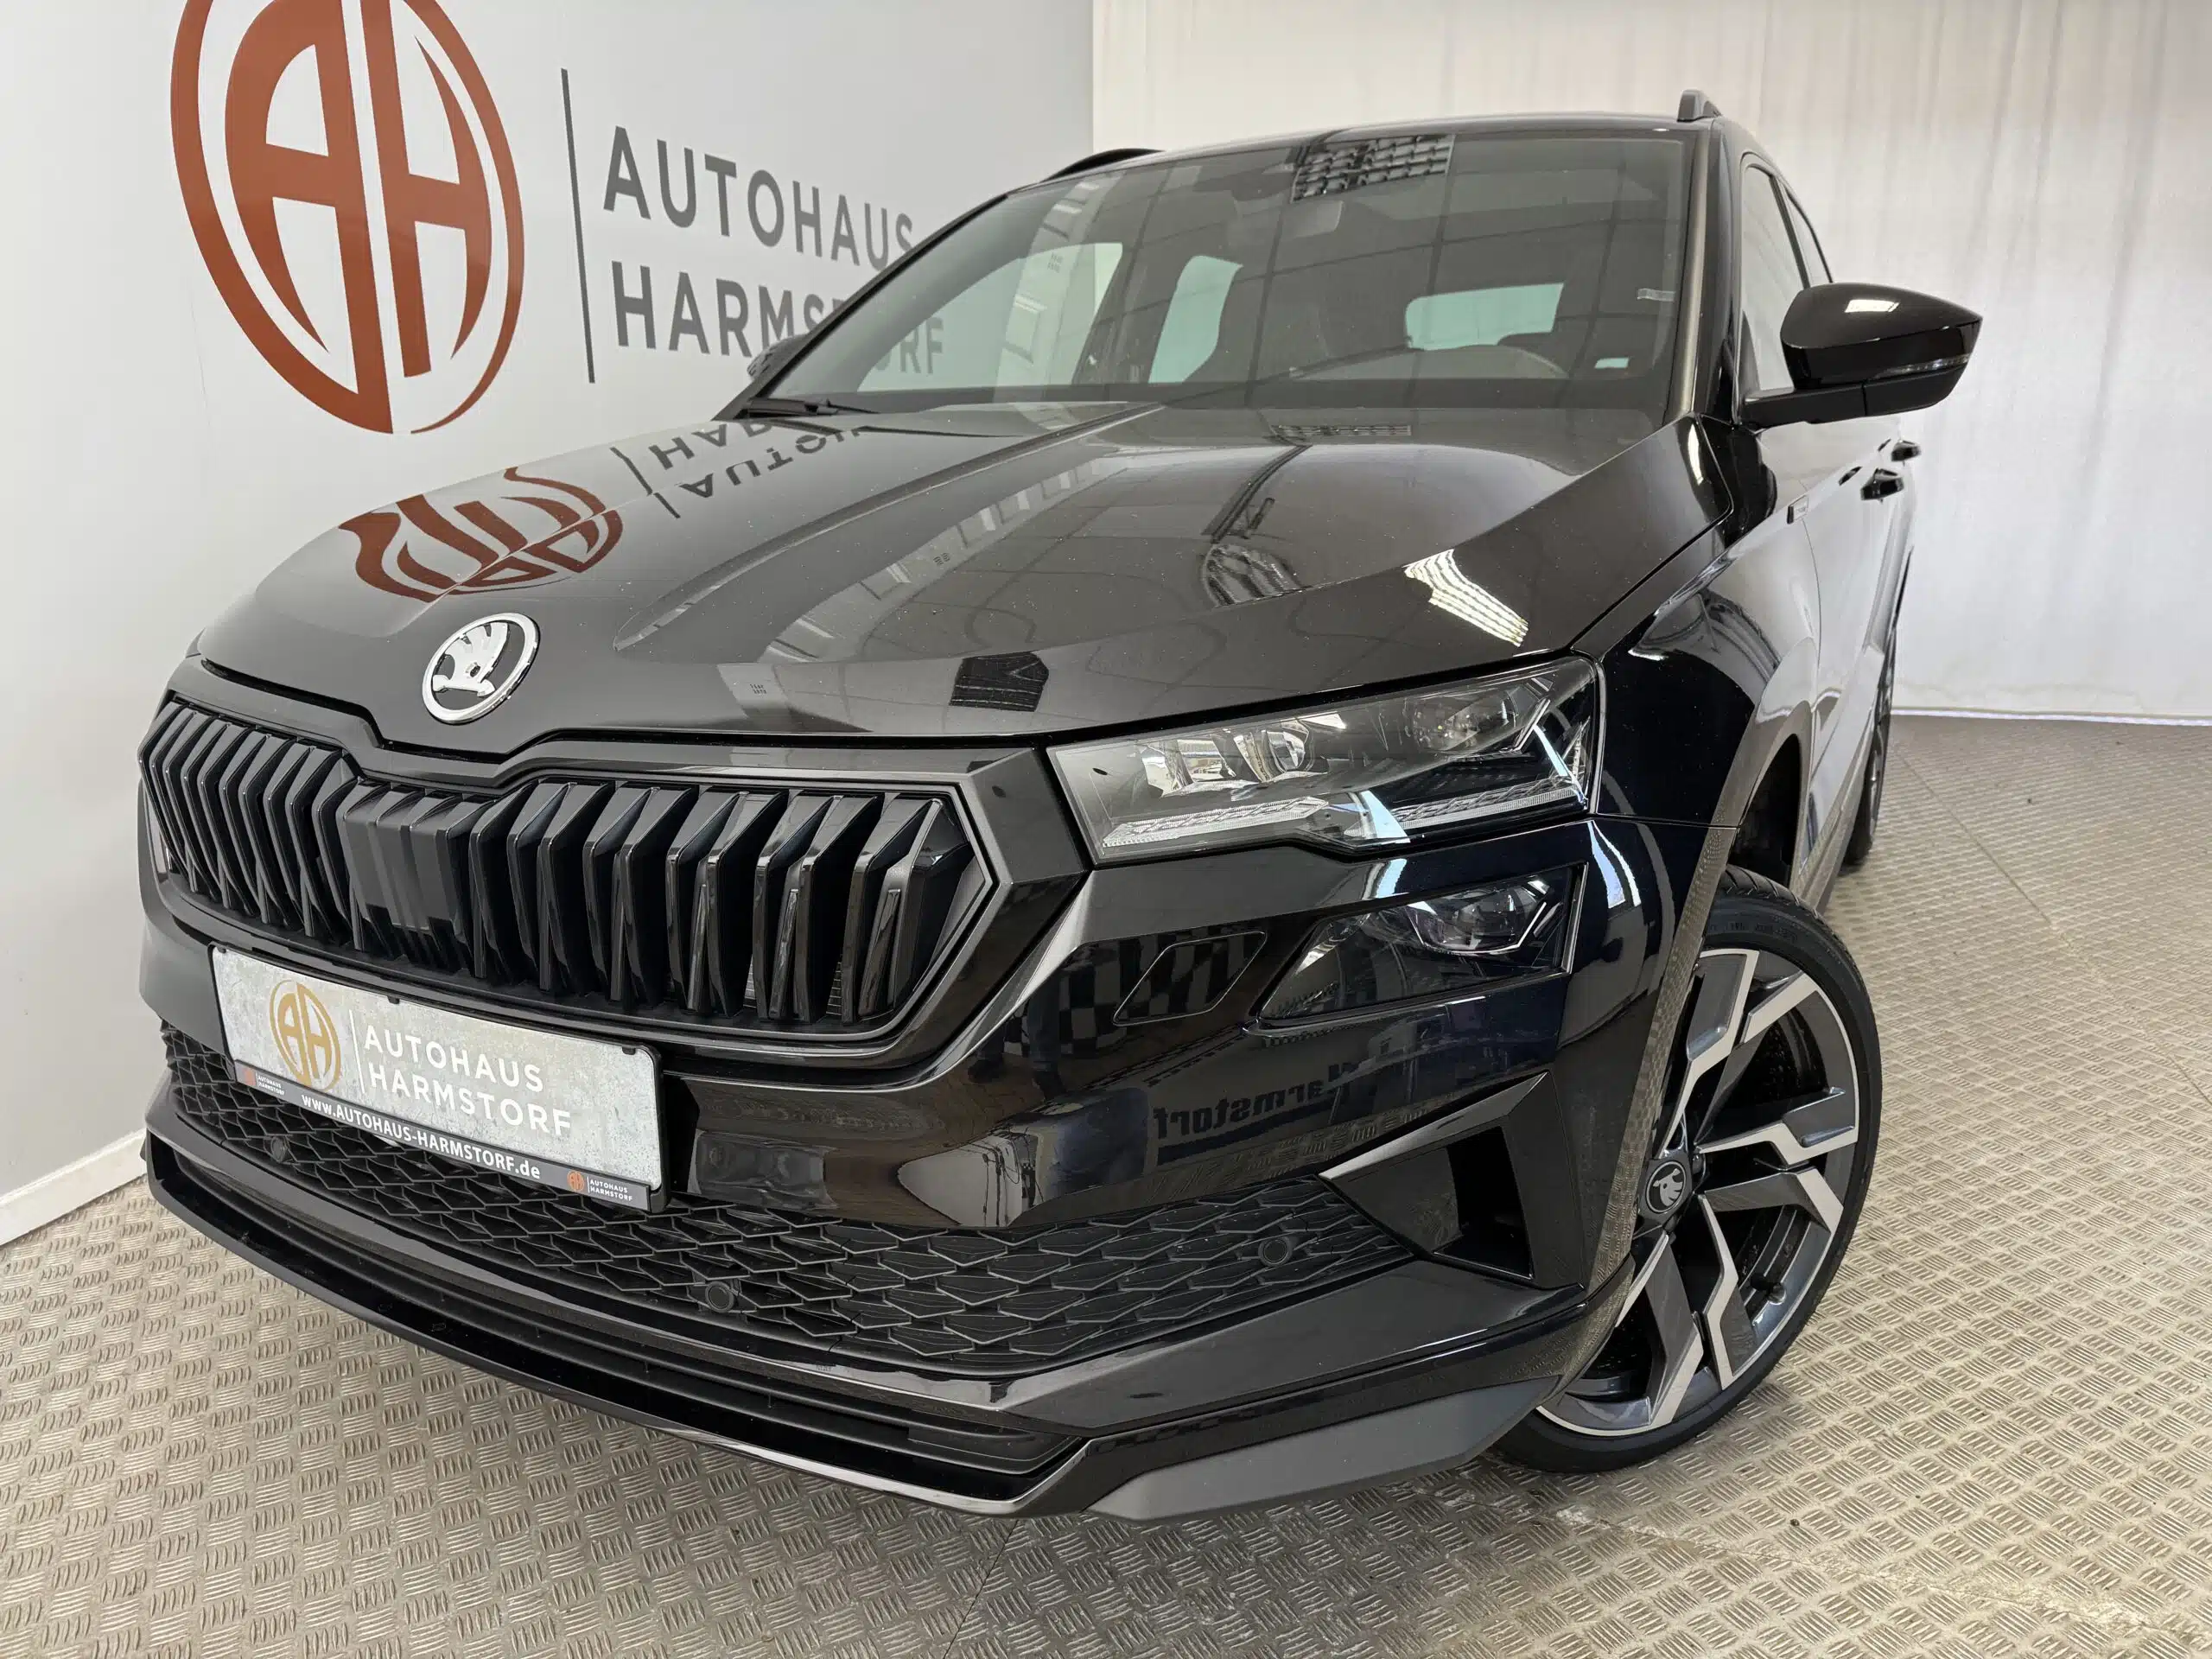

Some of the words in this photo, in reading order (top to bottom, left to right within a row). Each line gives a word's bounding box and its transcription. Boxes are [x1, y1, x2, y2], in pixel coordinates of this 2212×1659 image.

[603, 126, 913, 271] AUTOHAUS
[611, 261, 944, 375] HARMSRF
[364, 1025, 544, 1092] AUTOHAUS
[301, 1094, 541, 1180] www.AUTOHAUS-HARMSTORF.de
[368, 1063, 572, 1137] HARMSTORF
[589, 1179, 628, 1194] AUTOHAUS
[590, 1185, 633, 1202] HARMSTORF
